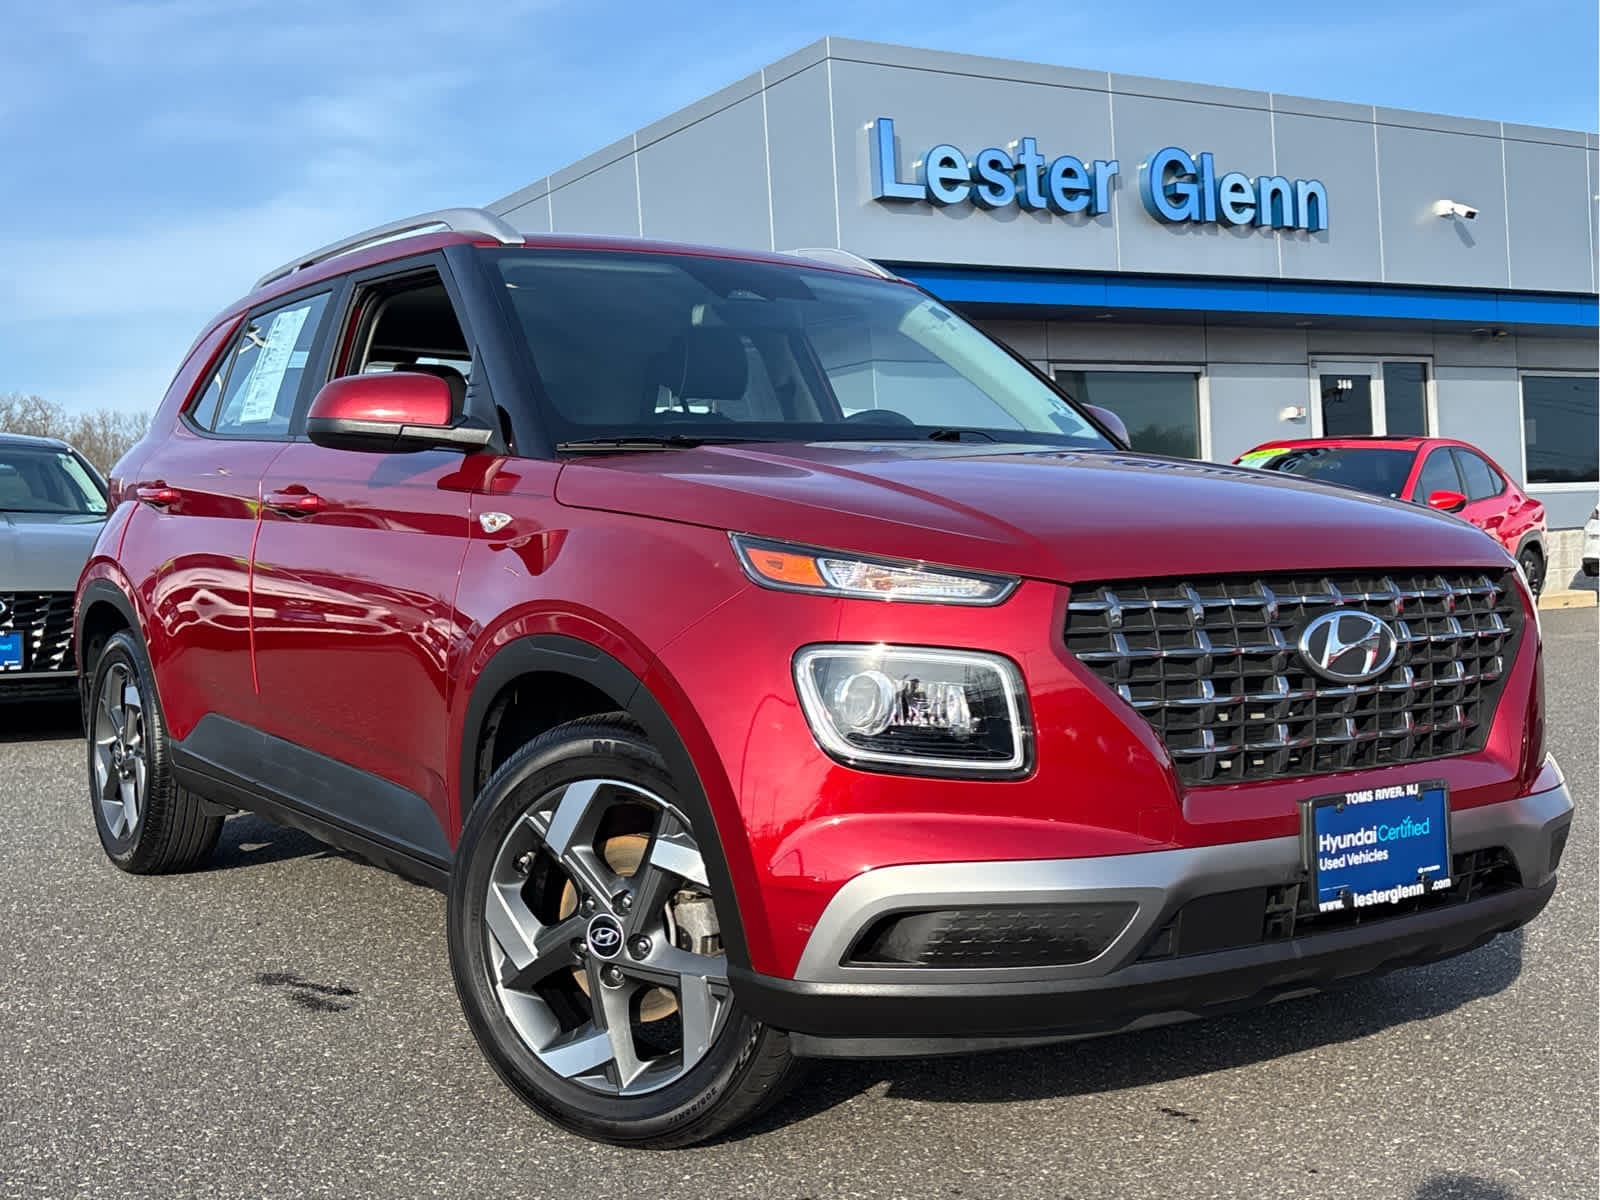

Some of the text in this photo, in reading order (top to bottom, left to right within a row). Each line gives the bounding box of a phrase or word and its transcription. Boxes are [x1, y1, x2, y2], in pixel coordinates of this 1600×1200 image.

[869, 117, 1328, 232] Lester Glenn
[1345, 791, 1374, 805] TOMS
[1406, 783, 1419, 796] NJ
[1319, 816, 1430, 854] Hyundai Certified
[1319, 849, 1389, 871] Used Vehicles
[1318, 900, 1345, 913] www.
[1353, 882, 1425, 908] lesterglenn
[1431, 878, 1452, 891] .com
